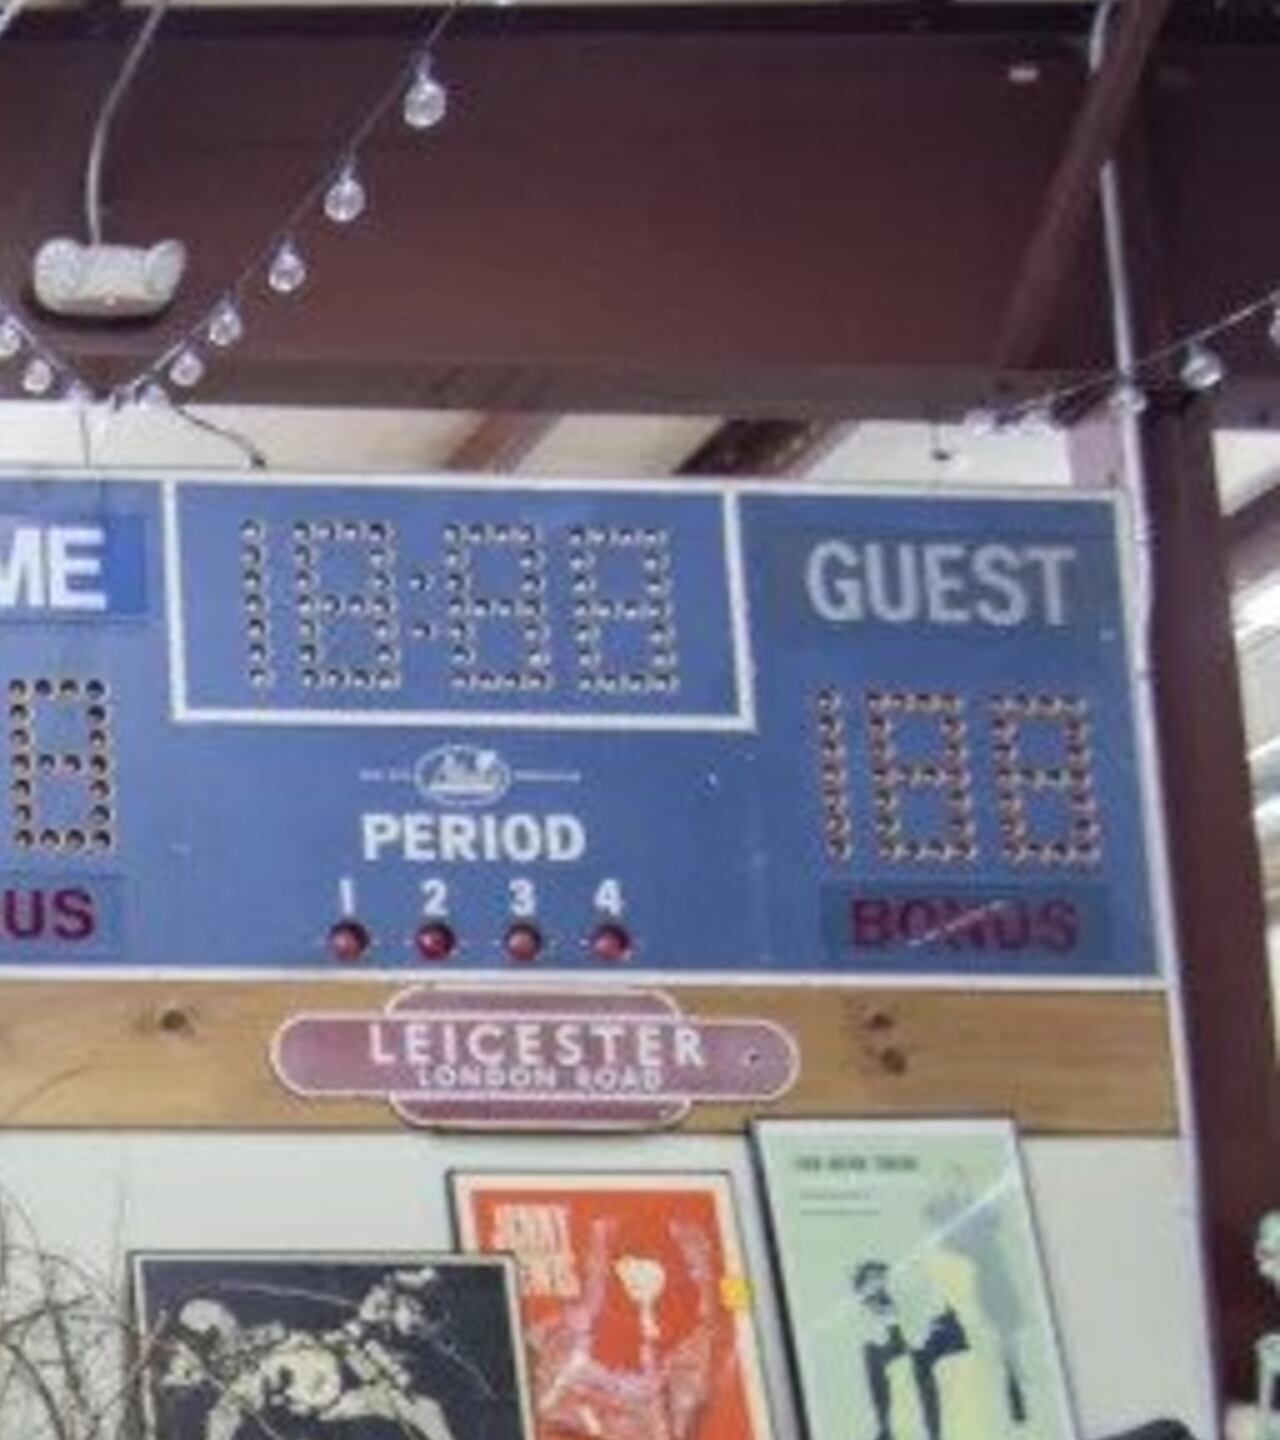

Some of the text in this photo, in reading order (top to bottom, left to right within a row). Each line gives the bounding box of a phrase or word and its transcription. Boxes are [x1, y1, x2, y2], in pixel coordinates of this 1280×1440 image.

[804, 539, 1077, 627] GUEST
[360, 813, 586, 860] PERIOD
[339, 879, 623, 915] 1 2 3 4
[851, 898, 1077, 952] BONUS
[368, 1023, 708, 1066] LEICESTER
[417, 1064, 662, 1092] LONDON ROAD
